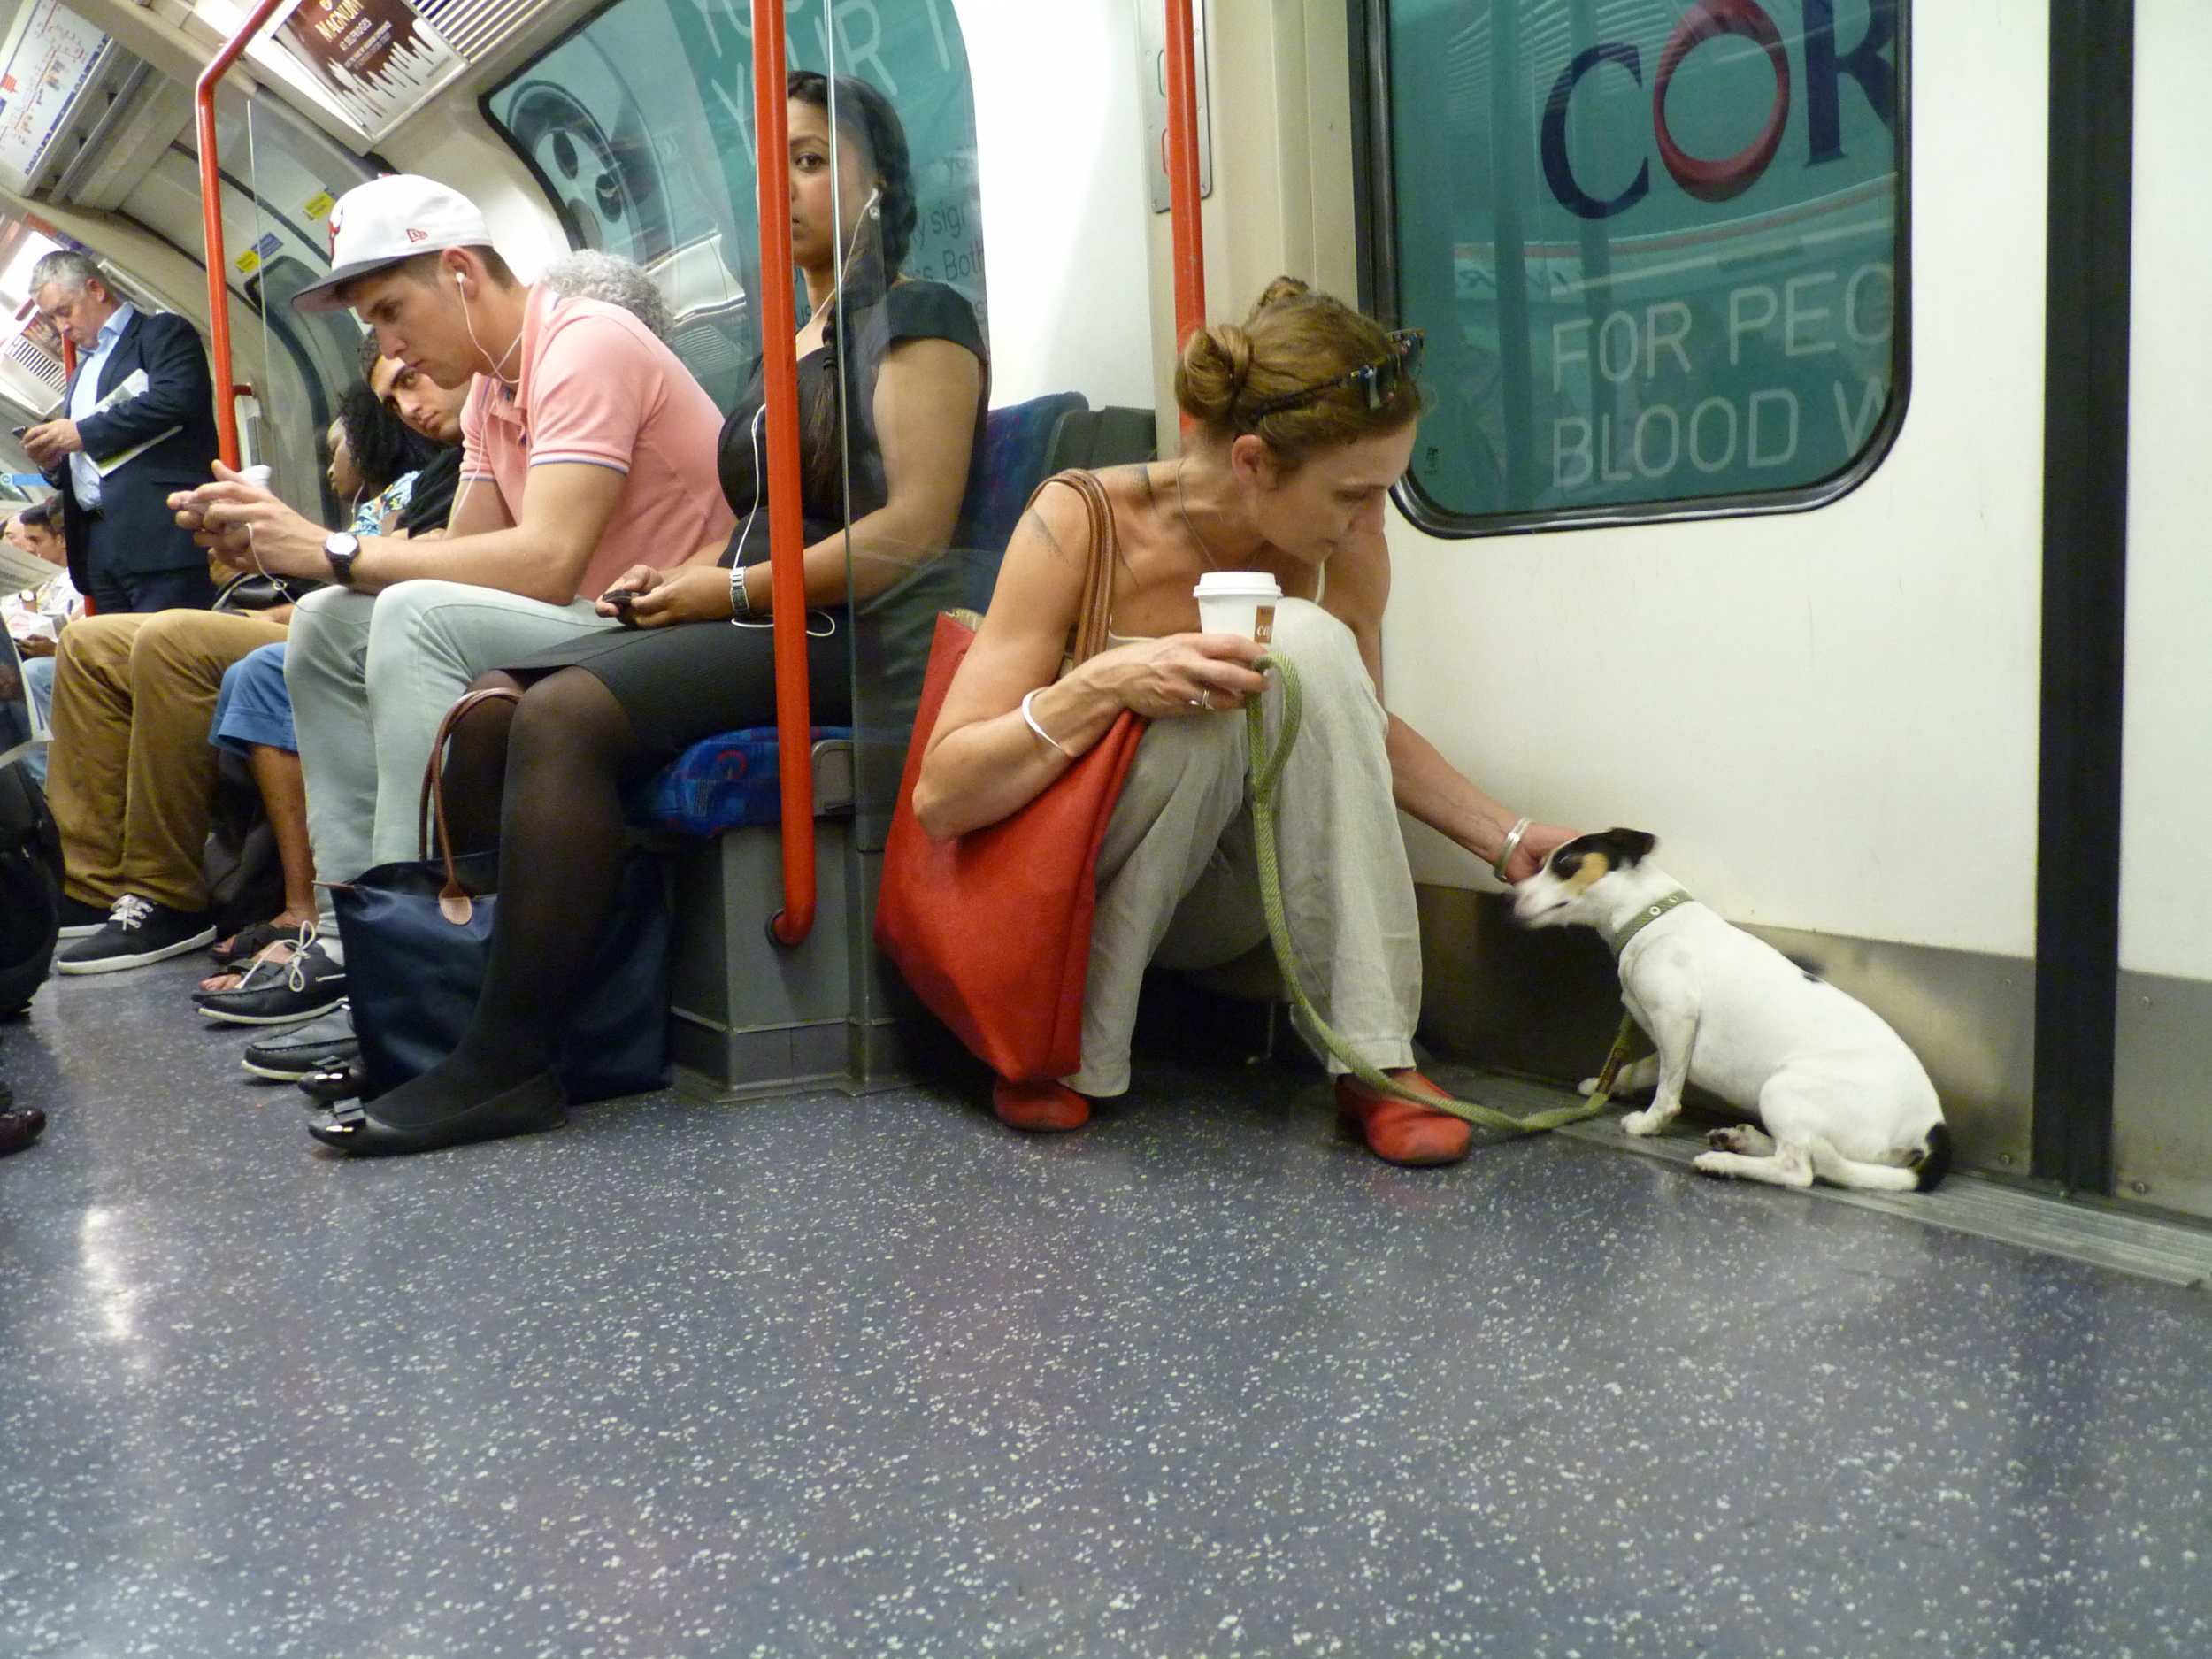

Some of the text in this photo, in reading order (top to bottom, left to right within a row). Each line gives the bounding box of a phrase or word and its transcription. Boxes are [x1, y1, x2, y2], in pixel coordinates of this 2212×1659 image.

[315, 0, 365, 42] MAGNUM
[1553, 301, 1692, 393] FOR
[1553, 388, 1800, 488] BLOOD
